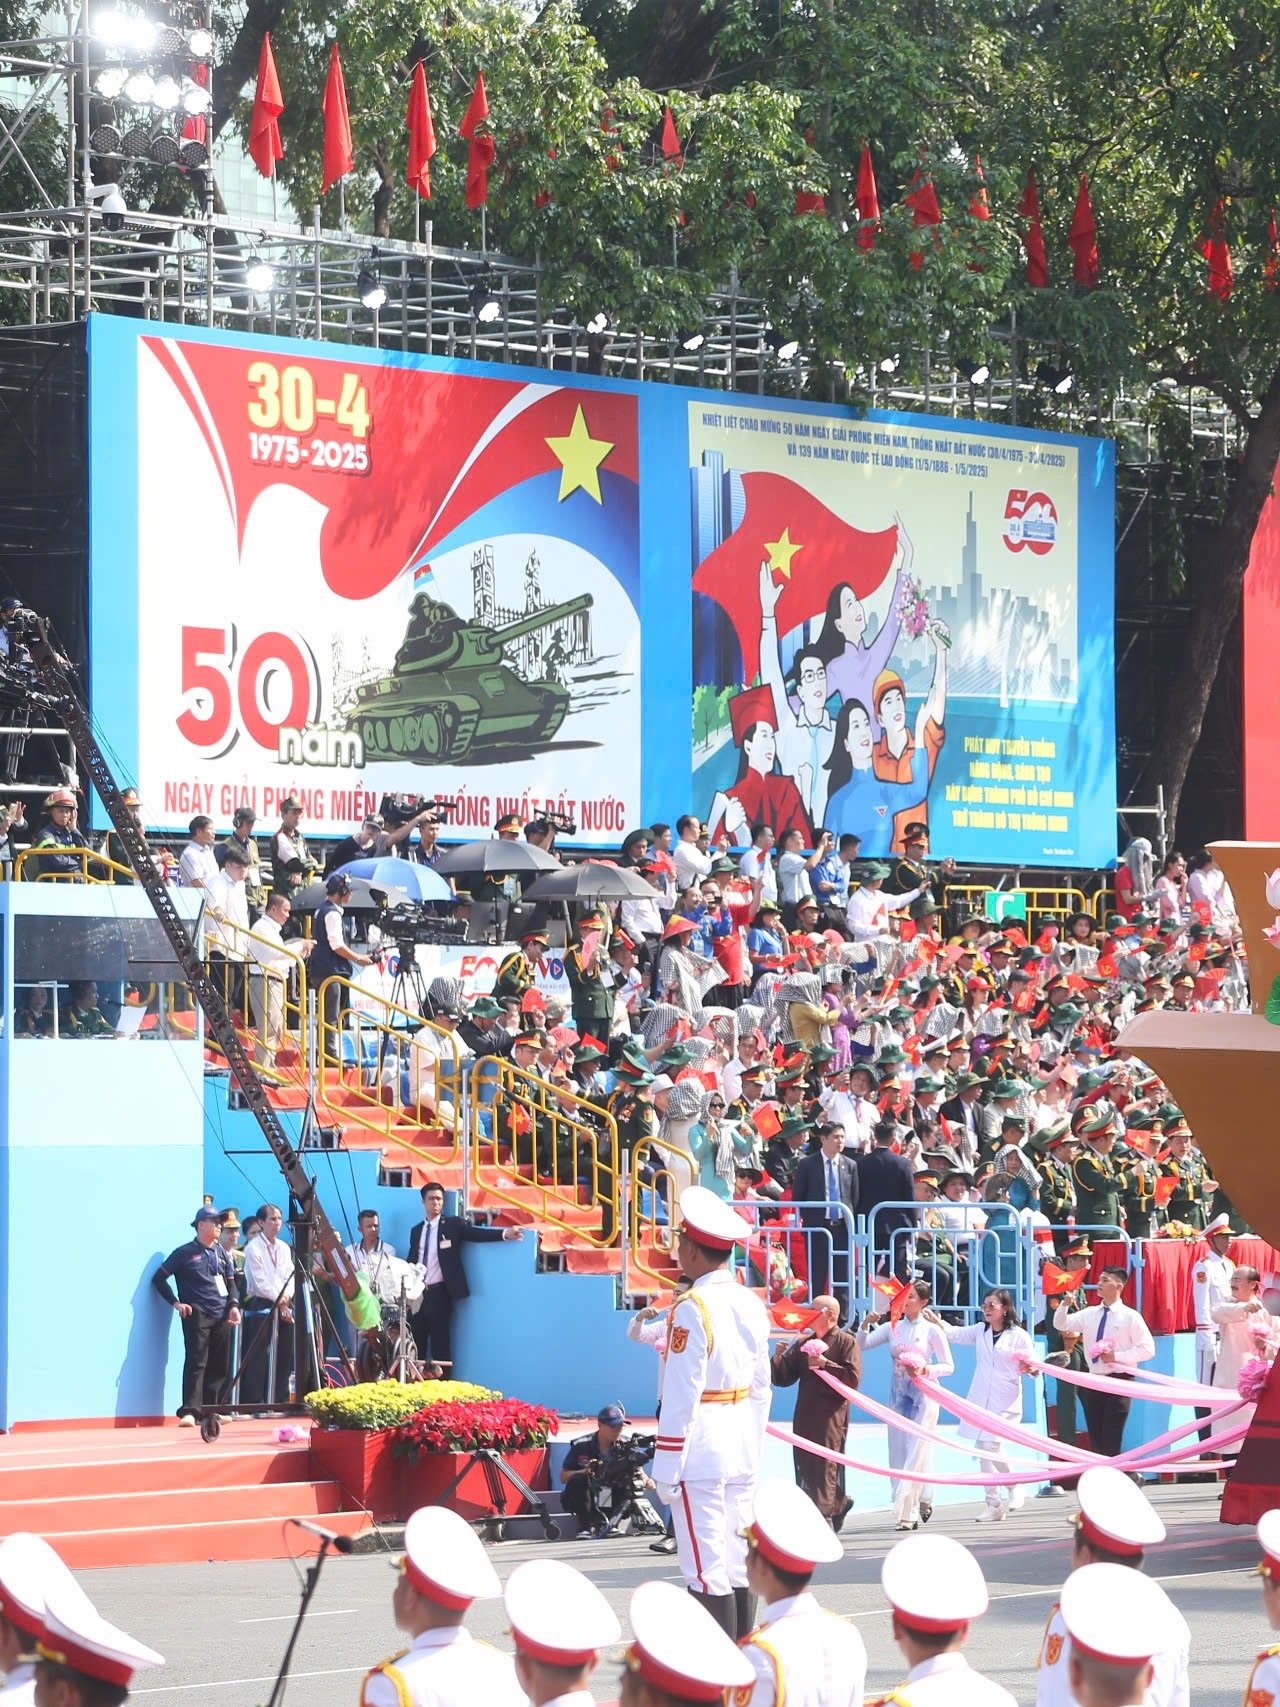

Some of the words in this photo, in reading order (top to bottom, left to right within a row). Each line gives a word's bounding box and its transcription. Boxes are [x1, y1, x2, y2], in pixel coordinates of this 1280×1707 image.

[247, 361, 370, 438] 30-4
[702, 412, 722, 429] NHIỆT
[724, 416, 737, 430] LIỆT
[739, 417, 759, 432] CHÀO
[783, 421, 793, 436] 50
[249, 432, 369, 471] 1975-2025
[799, 444, 812, 458] 139
[881, 454, 894, 467] LAO
[175, 625, 311, 751] 50
[278, 721, 366, 769] năm
[164, 776, 214, 814] NGÀY
[220, 773, 257, 816] GIẢI
[330, 780, 377, 822] MIỀN
[434, 784, 490, 827] THỐNG
[581, 794, 625, 831] NƯỚC
